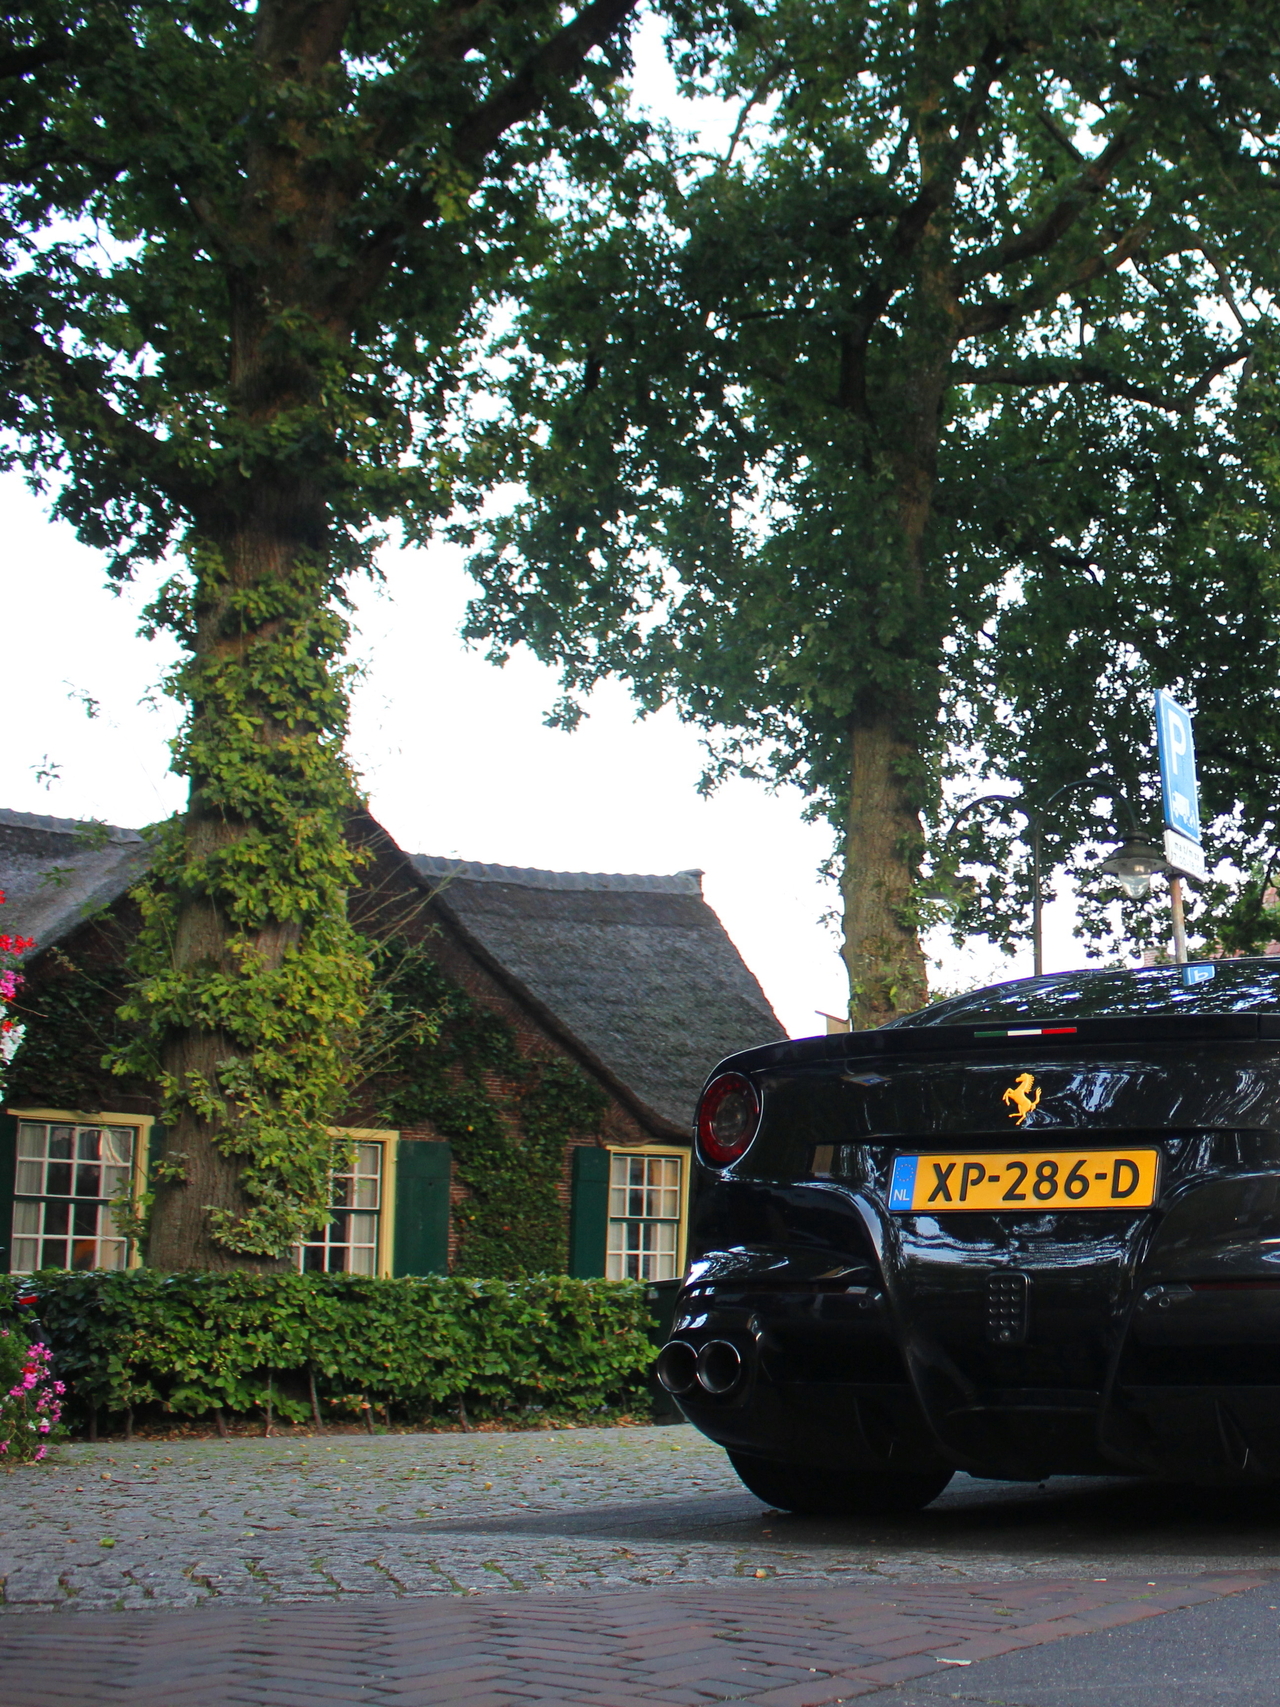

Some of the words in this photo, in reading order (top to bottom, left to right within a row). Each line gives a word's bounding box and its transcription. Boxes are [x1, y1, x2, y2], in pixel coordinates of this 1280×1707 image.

[1167, 708, 1187, 775] P
[893, 1188, 910, 1201] NL
[927, 1158, 1140, 1202] XP-286-D
